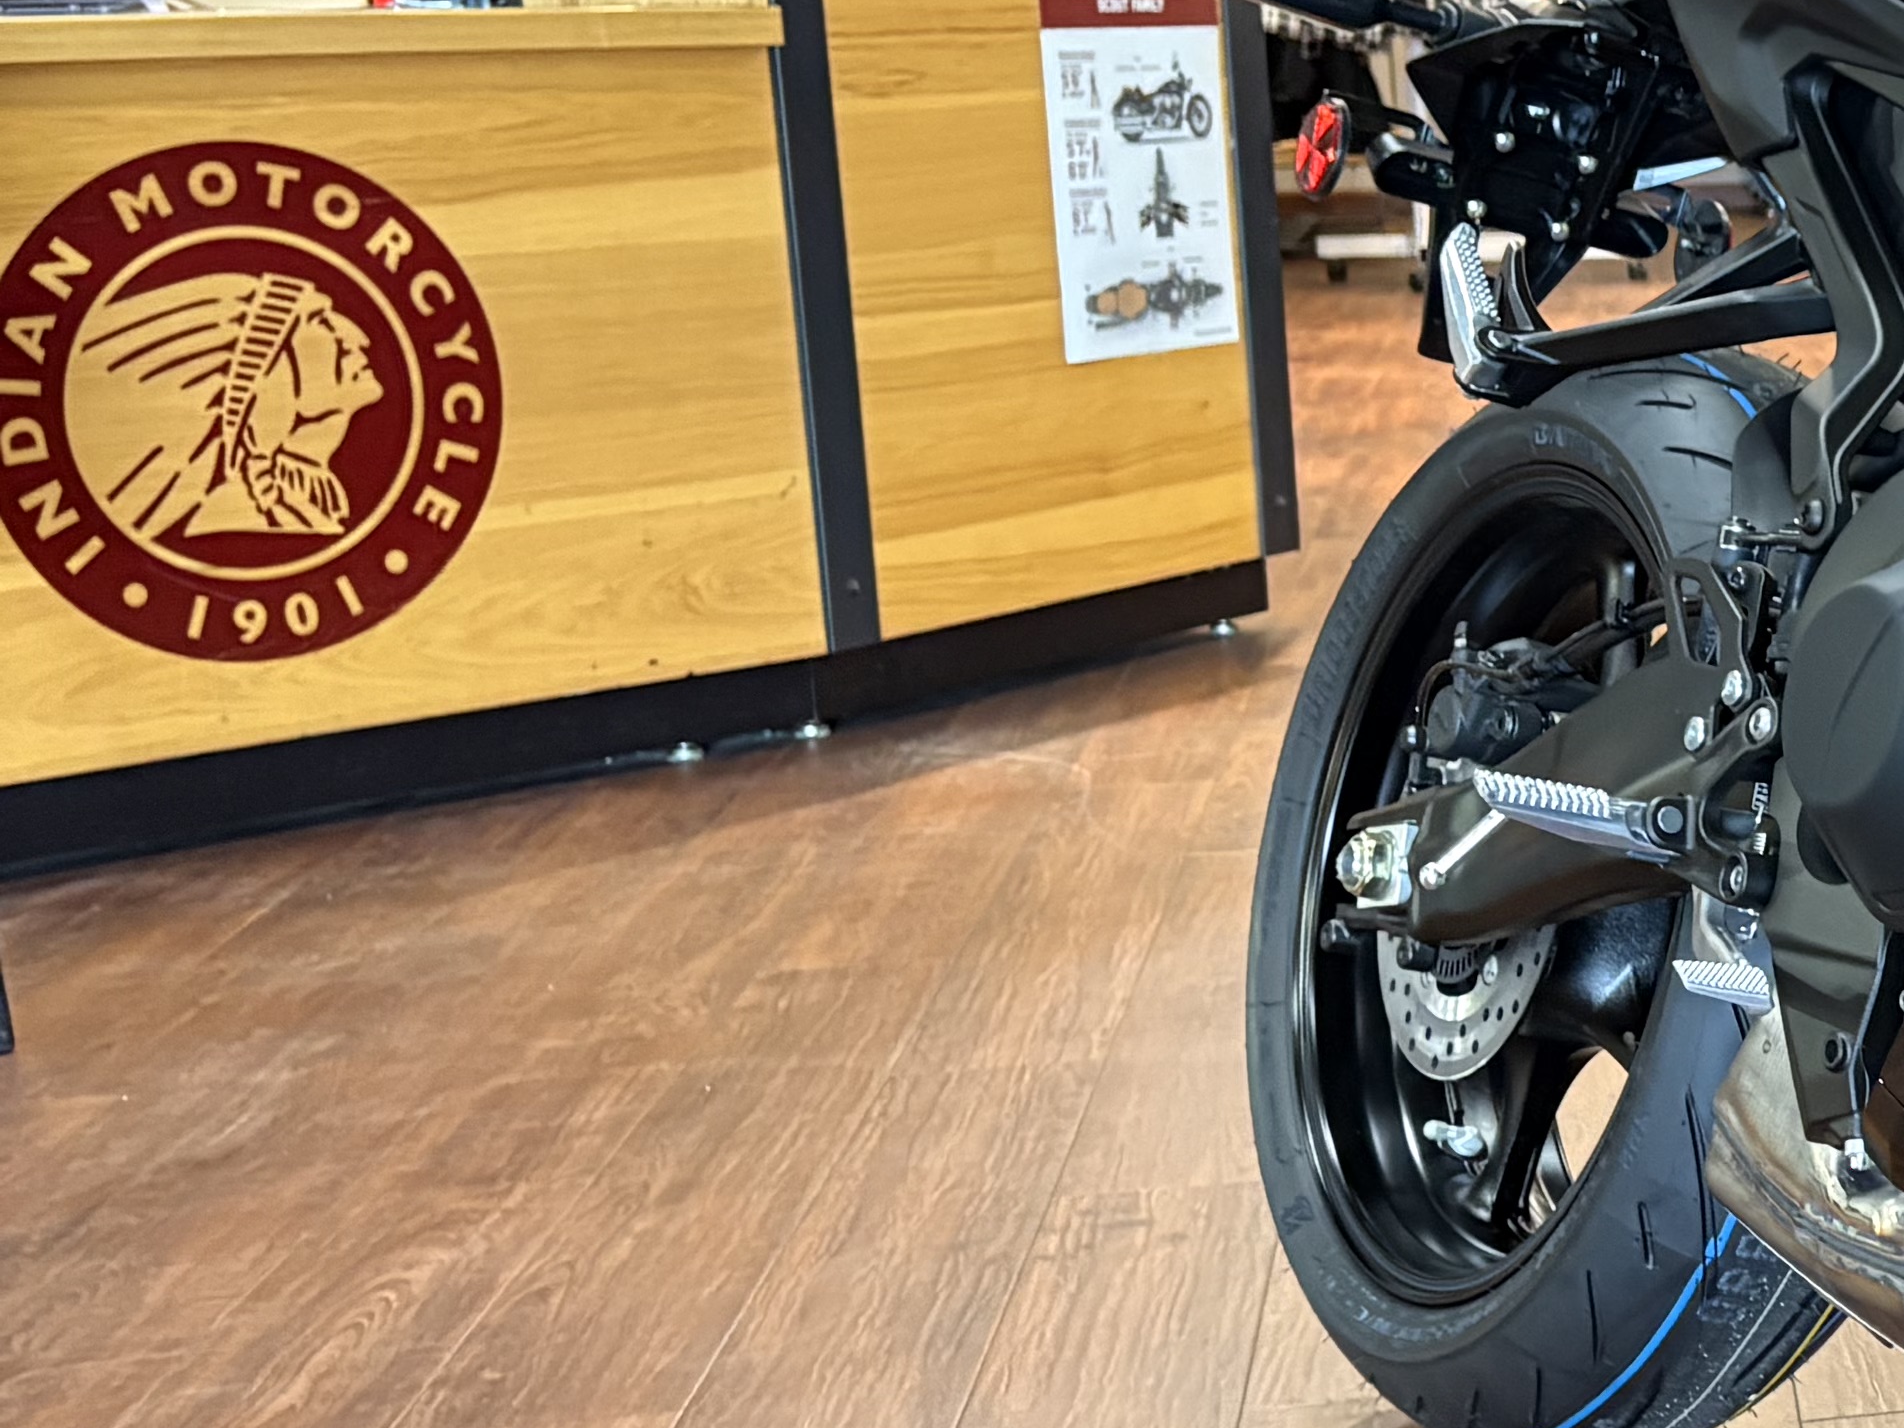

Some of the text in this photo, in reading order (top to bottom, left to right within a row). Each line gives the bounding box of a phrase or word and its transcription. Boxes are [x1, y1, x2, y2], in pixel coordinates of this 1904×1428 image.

[0, 160, 485, 576] INDIAN MOTORCYCLE
[186, 575, 365, 644] 1901
